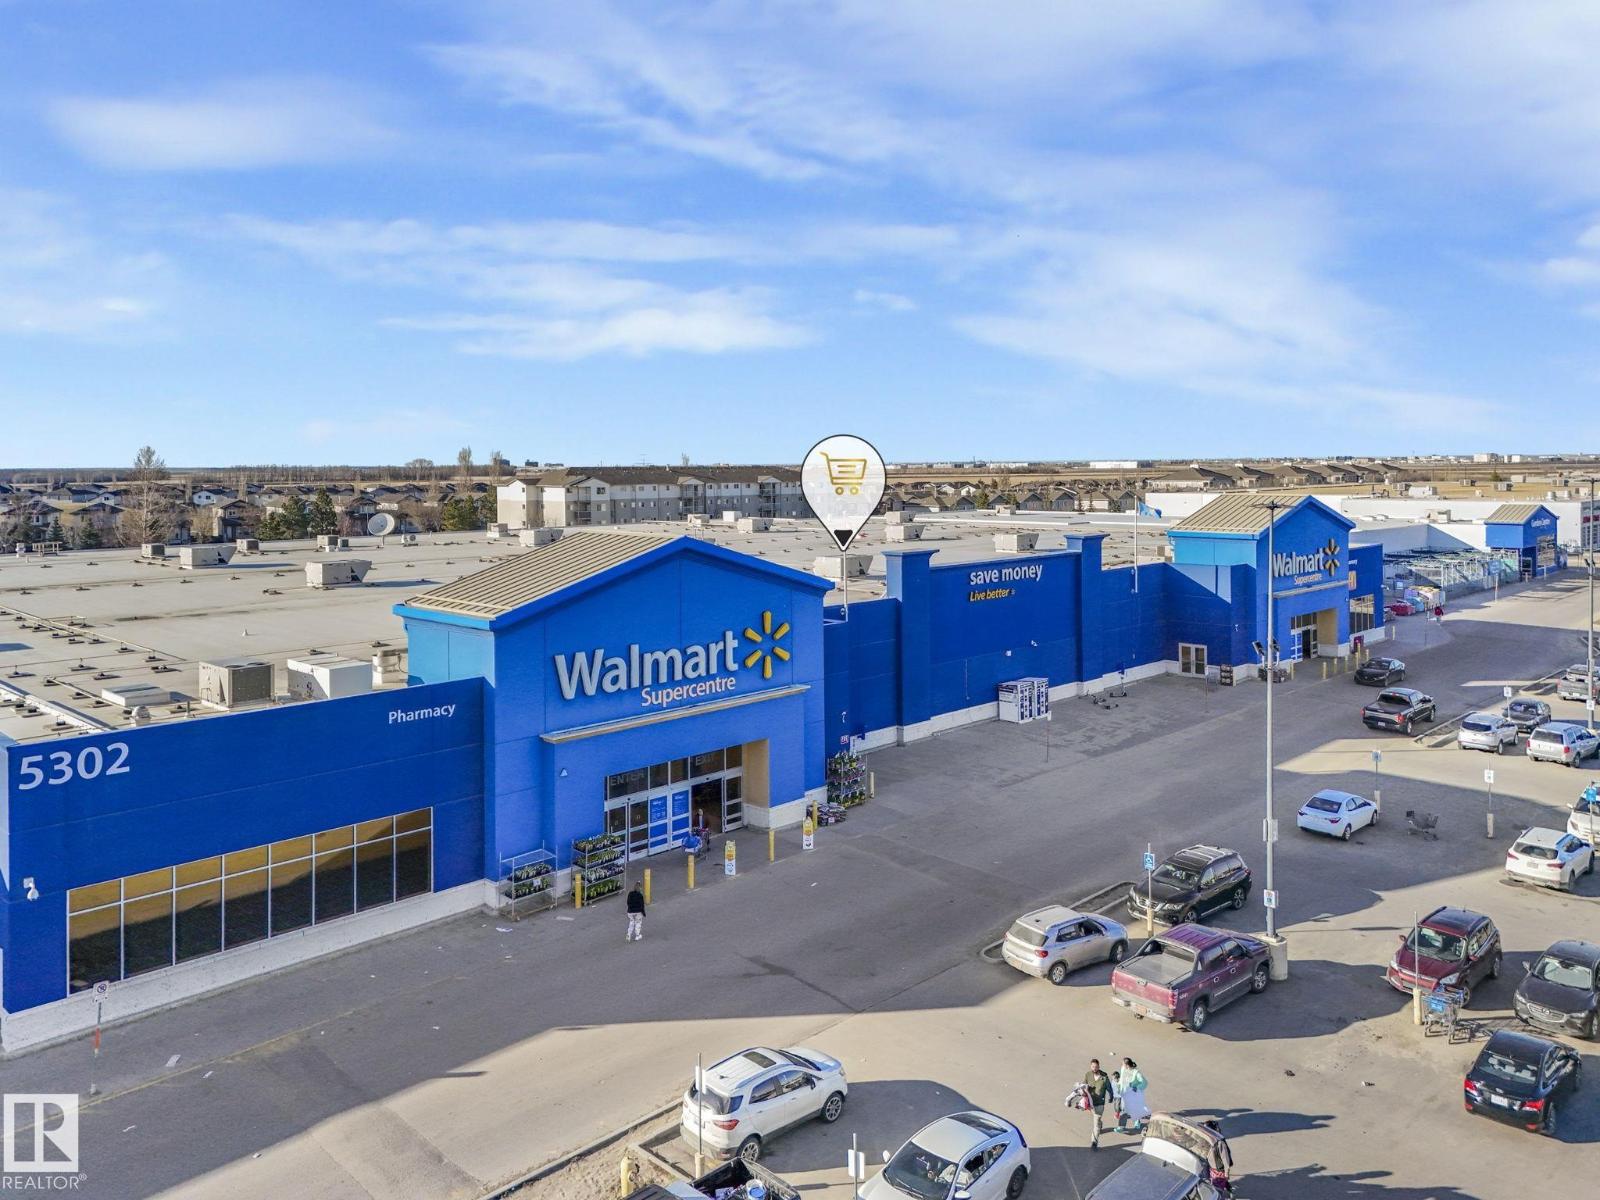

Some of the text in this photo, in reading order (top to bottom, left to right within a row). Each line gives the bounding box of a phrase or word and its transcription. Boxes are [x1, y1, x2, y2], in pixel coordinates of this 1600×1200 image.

[969, 564, 1043, 586] save money
[1272, 547, 1325, 578] Walmart
[969, 588, 1010, 602] Live better
[553, 630, 739, 701] Walmart
[641, 676, 737, 708] Supercentre
[388, 704, 456, 725] Pharmacy
[18, 742, 130, 790] 5302
[610, 773, 645, 787] ENTER
